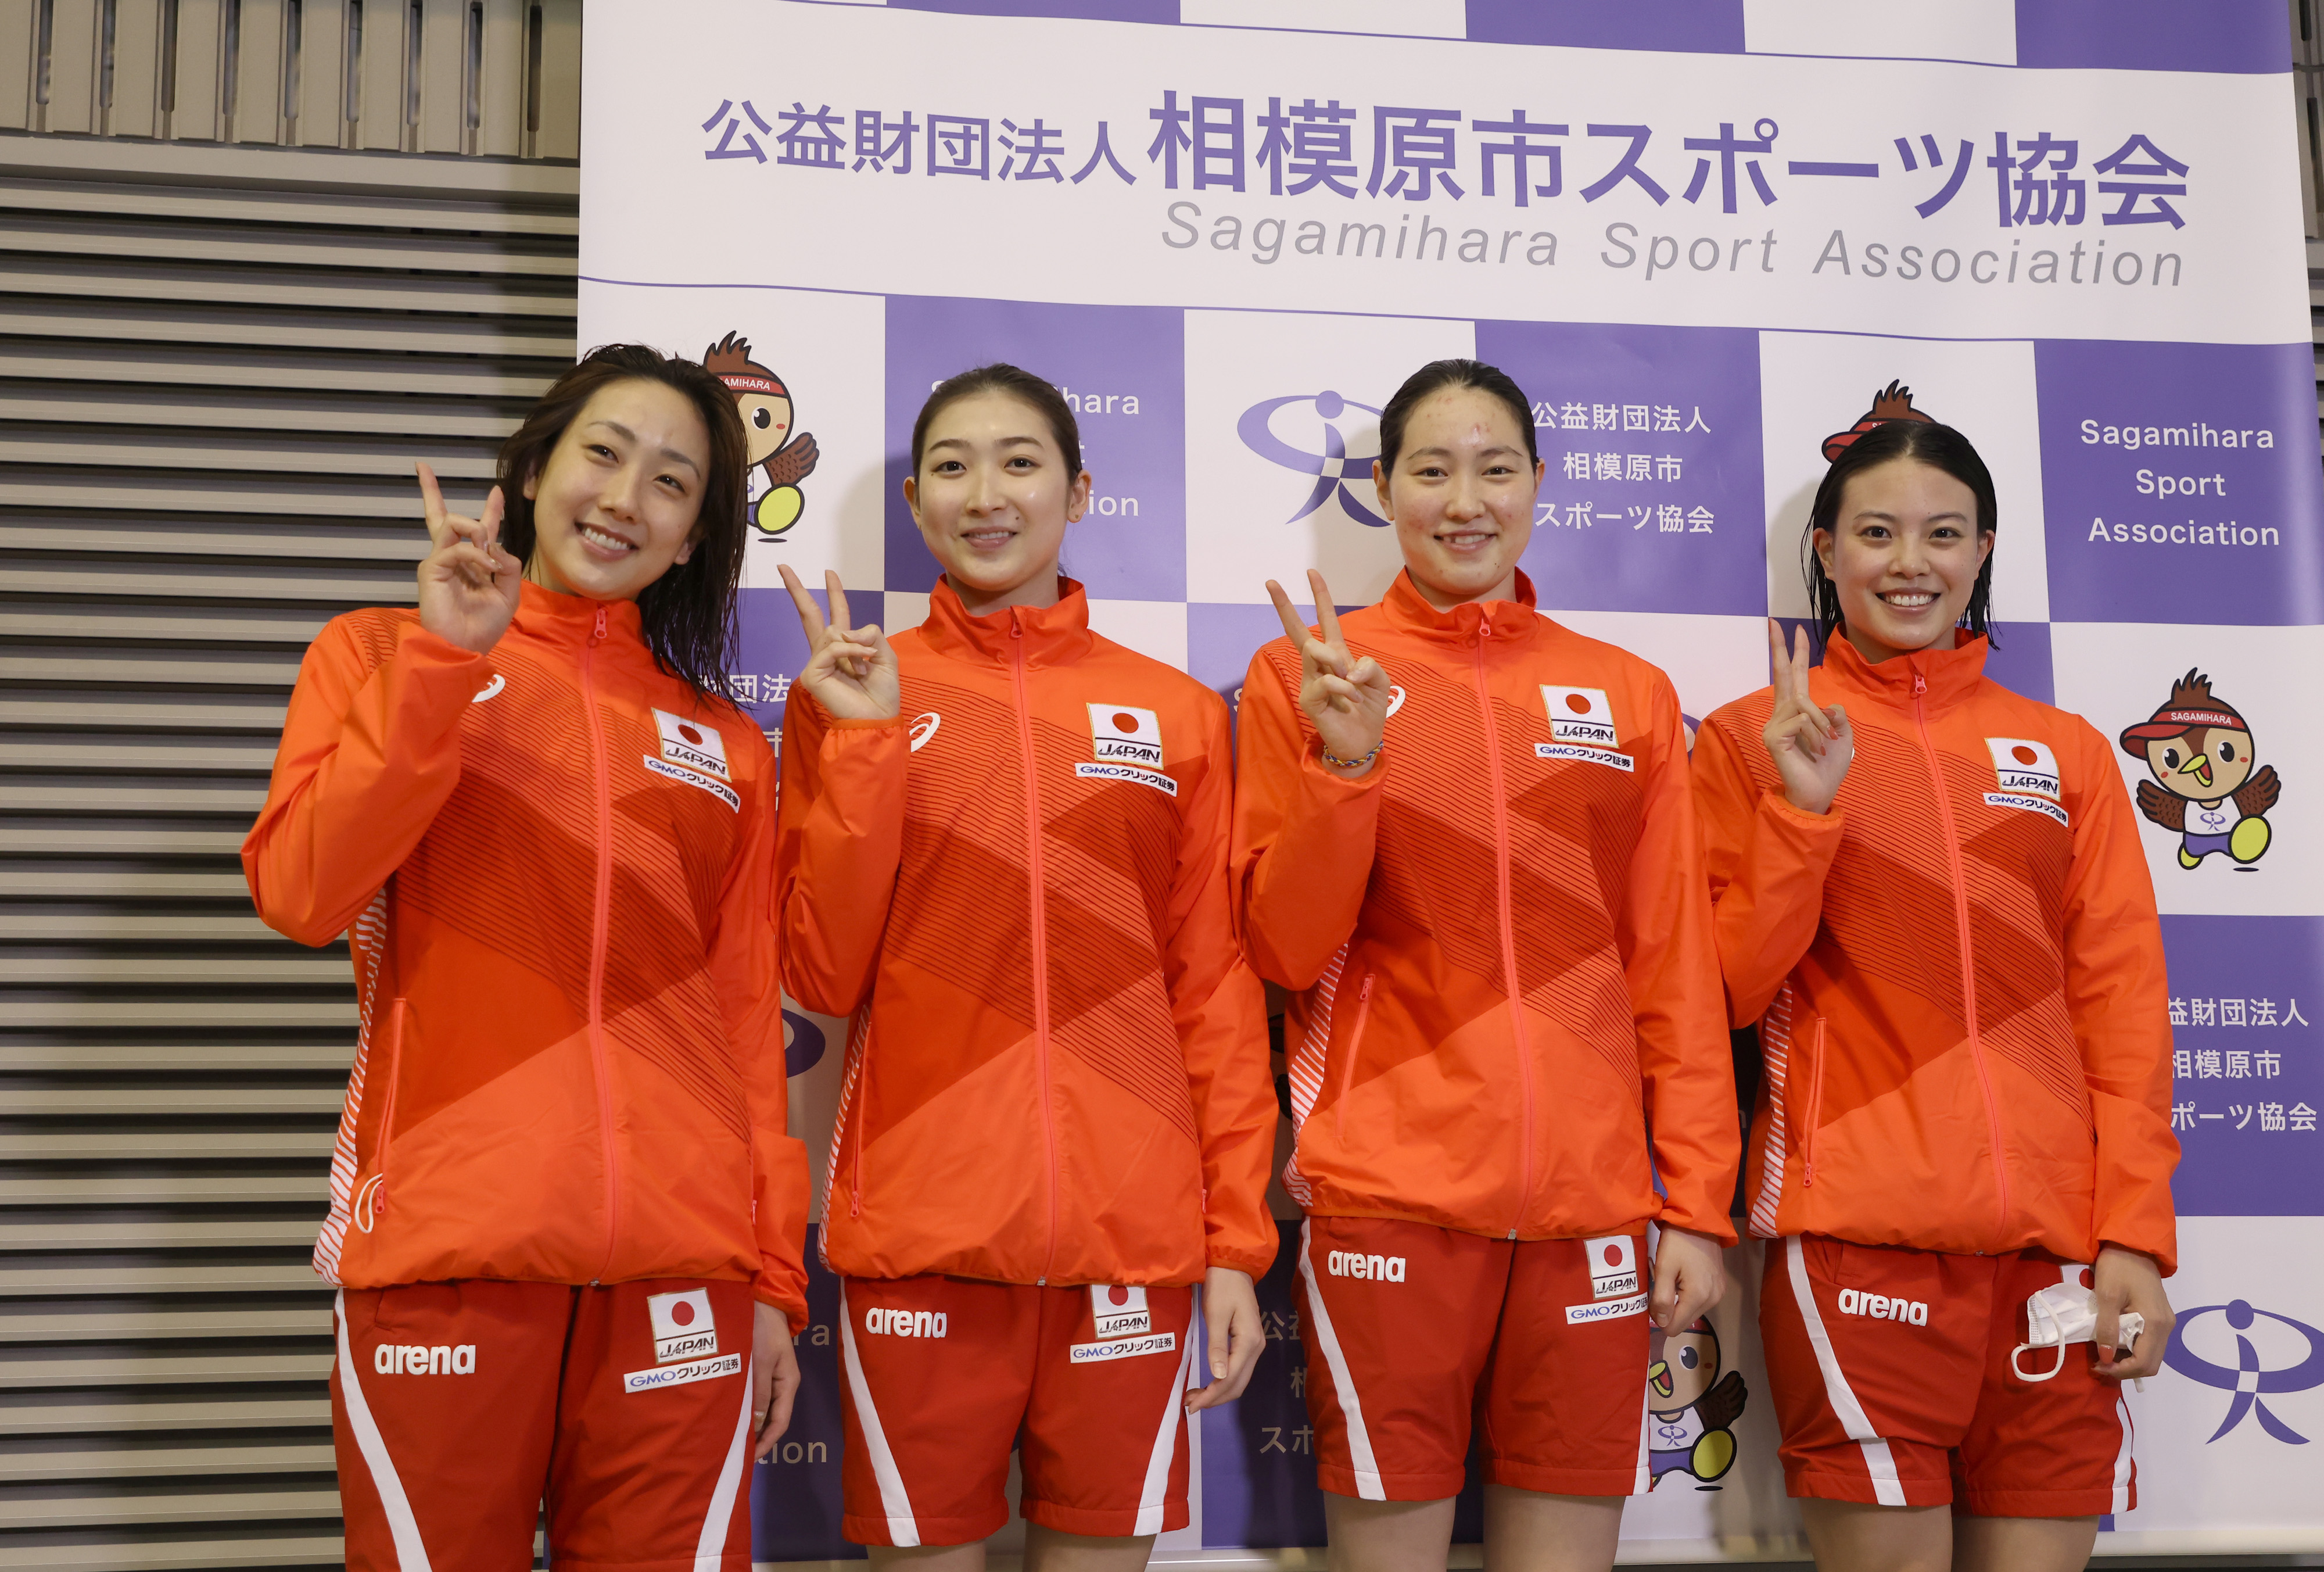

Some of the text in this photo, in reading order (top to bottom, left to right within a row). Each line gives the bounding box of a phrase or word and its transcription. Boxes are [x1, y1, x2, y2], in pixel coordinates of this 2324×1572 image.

[1161, 200, 2183, 287] Sagamihara Sport Association
[720, 378, 770, 391] AMIHARA
[1531, 401, 1712, 434] 公益財団法人
[2081, 418, 2275, 450] Sagamihara
[1563, 451, 1683, 483] 相模原市
[2135, 468, 2226, 500] Sport
[1534, 501, 1715, 534] スポーツ協会
[2088, 517, 2280, 546] Association
[1555, 725, 1613, 742] JAPAN
[2171, 712, 2232, 726] SAGAMIHARA
[665, 747, 726, 775] JAPAN
[1098, 744, 1160, 762] JAPAN
[2002, 775, 2058, 794] JAPAN
[1328, 1250, 1406, 1283] arena
[1595, 1276, 1636, 1294] JAPAN
[1838, 1288, 1928, 1327] arena
[865, 1307, 948, 1339] arena
[1098, 1316, 1148, 1334] JAPAN
[374, 1343, 476, 1376] arena
[659, 1335, 714, 1358] JAPAN
